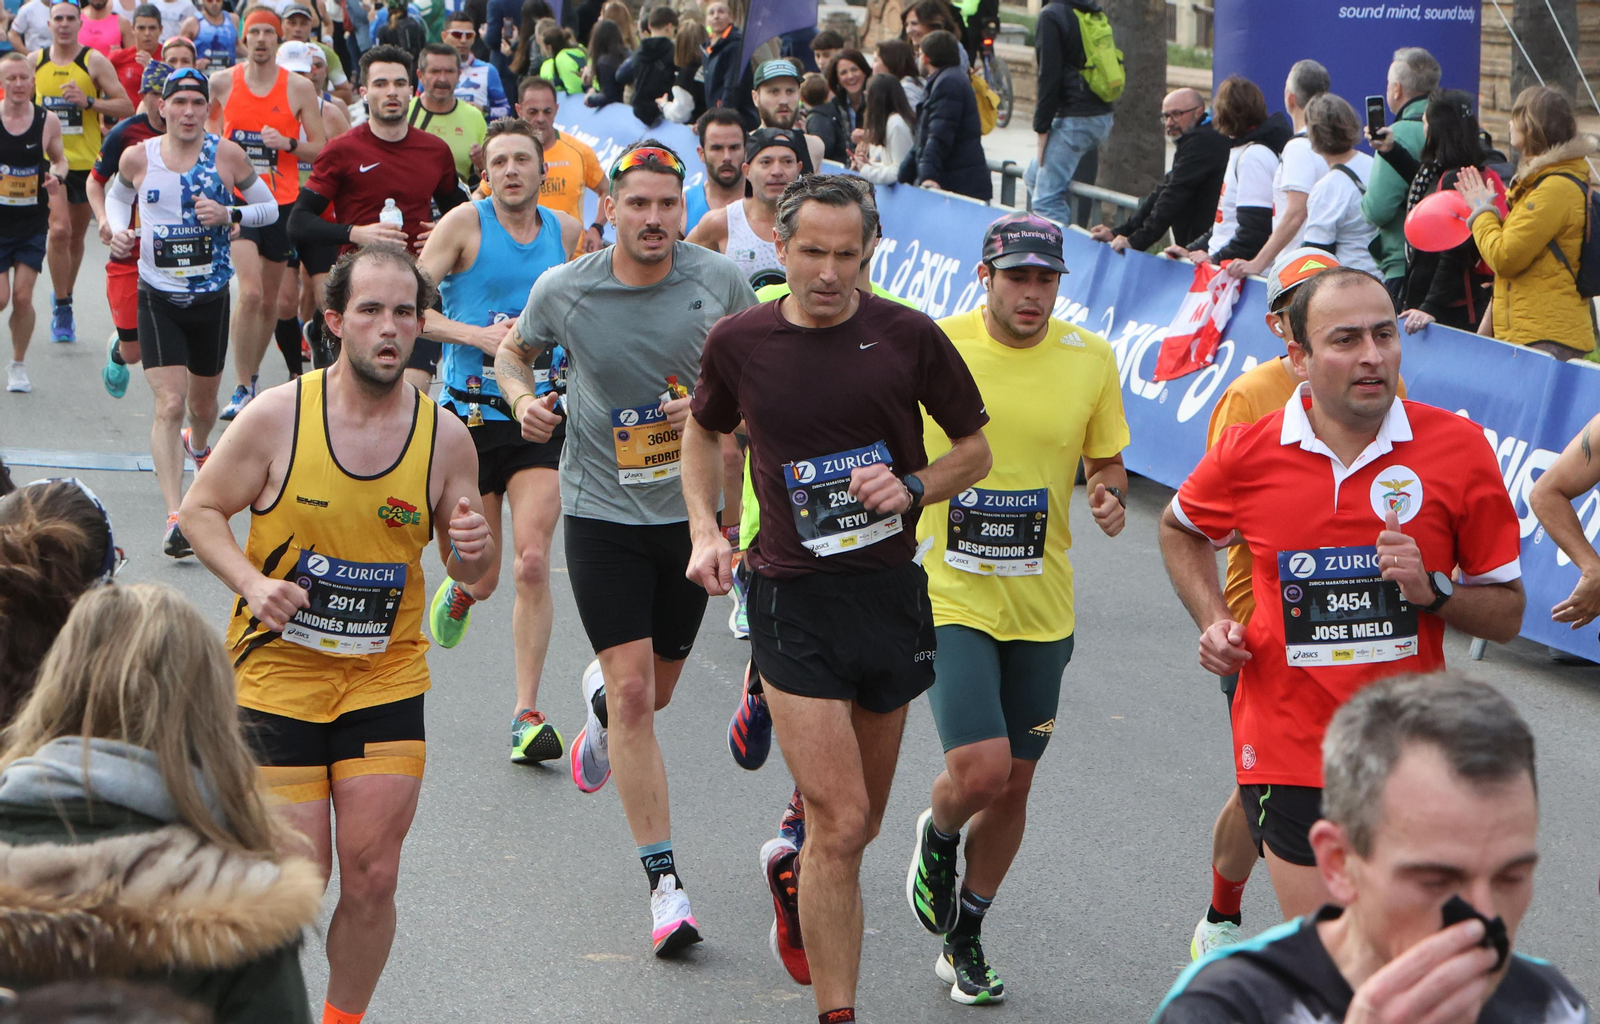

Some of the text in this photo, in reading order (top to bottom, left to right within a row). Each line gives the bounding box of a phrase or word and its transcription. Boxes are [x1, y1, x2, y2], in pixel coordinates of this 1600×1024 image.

[1338, 4, 1475, 23] sound mind, sound body
[172, 225, 206, 236] ZURICH
[1007, 232, 1020, 240] Post
[1021, 230, 1046, 240] Running
[172, 243, 194, 254] 3354
[177, 258, 191, 267] TIM
[647, 429, 679, 446] 3608
[644, 449, 681, 466] PEDRIT
[822, 449, 882, 475] ZURICH
[983, 494, 1038, 507] ZURICH
[836, 511, 868, 530] YEYU
[980, 522, 1015, 538] 2605
[957, 540, 1035, 557] DESPEDIDOR 3
[1324, 554, 1380, 571] ZURIC
[335, 564, 395, 582] ZURICH
[327, 594, 366, 613] 2914
[1326, 591, 1372, 612] 3454
[294, 610, 388, 634] ANDRÉS MUÑOZ
[1311, 621, 1394, 641] JOSE MELO
